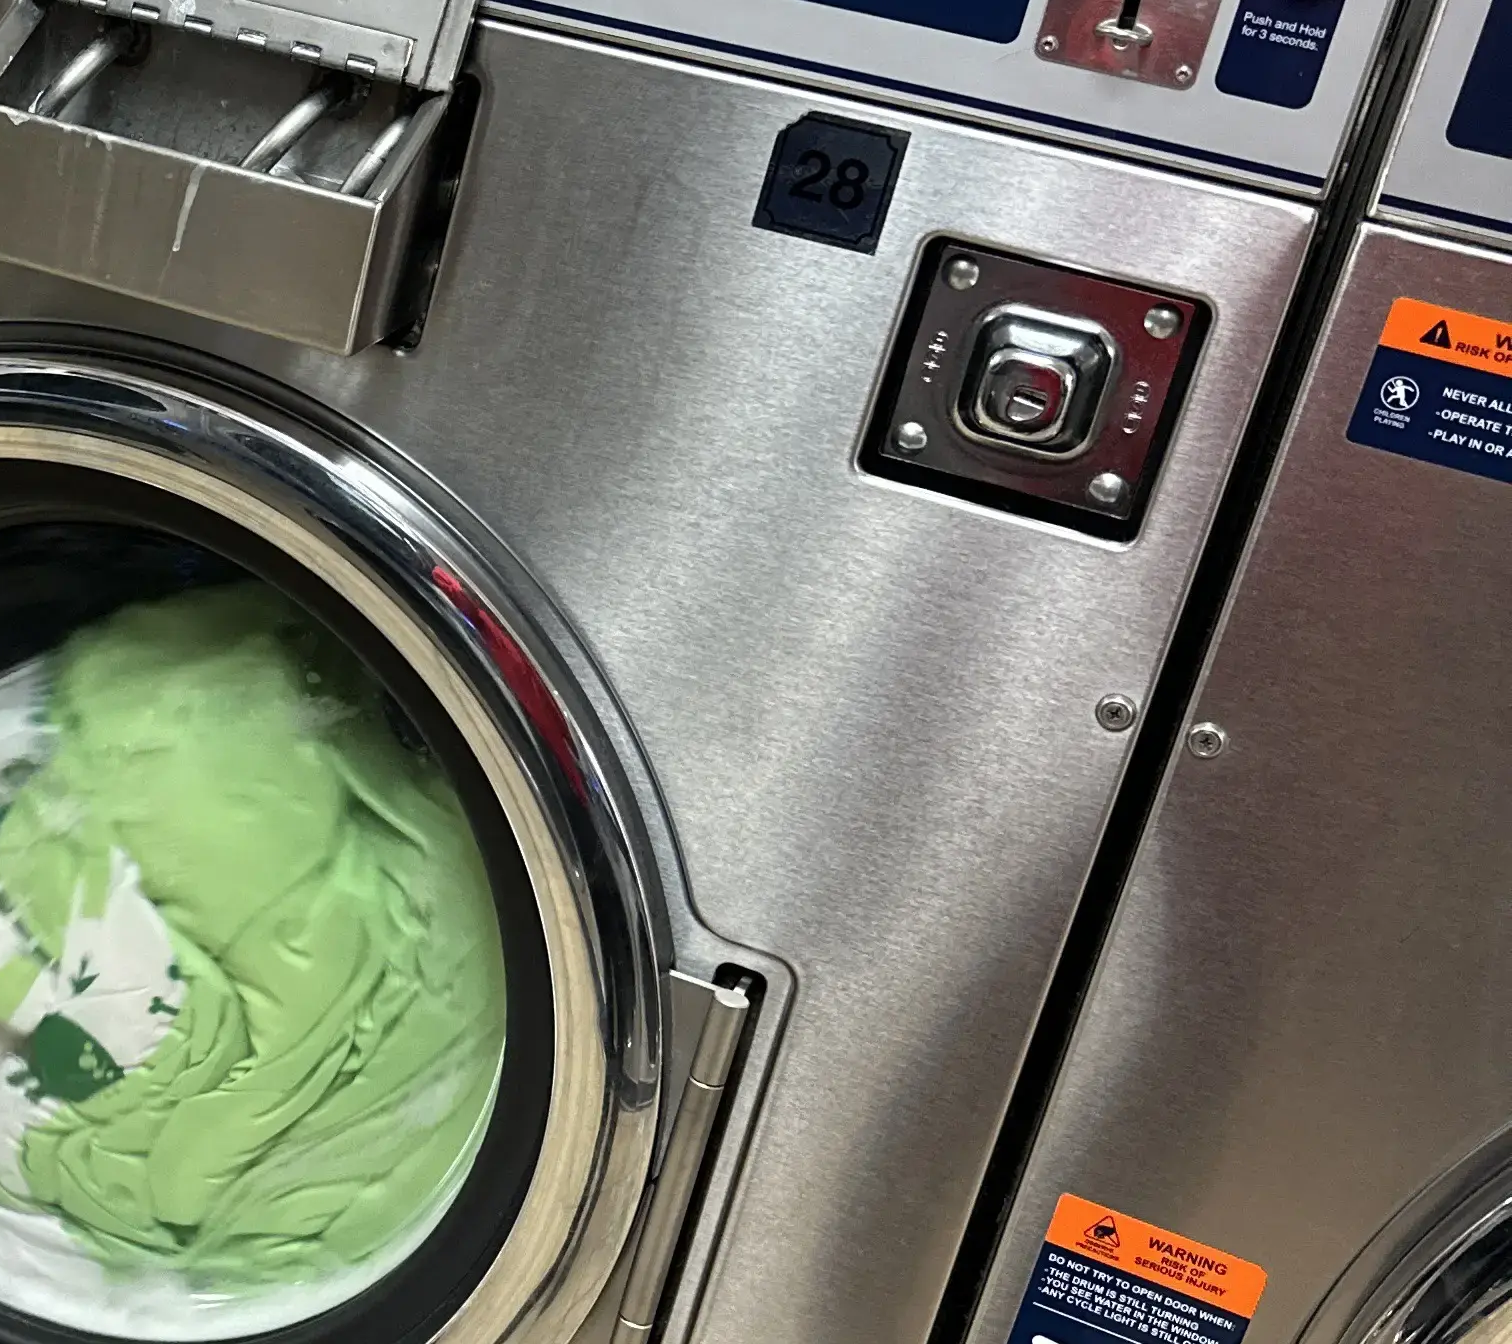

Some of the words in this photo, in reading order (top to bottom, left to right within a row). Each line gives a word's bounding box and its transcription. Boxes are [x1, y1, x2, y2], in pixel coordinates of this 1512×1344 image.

[1241, 25, 1257, 37] for
[1259, 29, 1267, 39] 3
[1269, 31, 1319, 52] seconds.
[1243, 11, 1273, 29] Push
[1274, 18, 1298, 33] and
[1298, 21, 1327, 39] Hold
[787, 149, 871, 211] 28
[1455, 342, 1490, 359] RISK
[1442, 387, 1487, 408] NEVER
[1468, 438, 1482, 450] IN
[1484, 443, 1504, 456] OR
[1149, 1237, 1227, 1275] WARNING
[1160, 1256, 1188, 1272] RISK
[1189, 1268, 1206, 1278] OF
[1048, 1252, 1065, 1264] DO
[1066, 1259, 1090, 1274] NOT
[1092, 1268, 1113, 1282] TRY
[1115, 1277, 1130, 1289] TO
[1131, 1285, 1162, 1302] OPEN
[1163, 1297, 1197, 1316] DOOR
[1134, 1256, 1183, 1280] SERIOUS
[1185, 1275, 1226, 1296] INJURY
[1066, 1295, 1102, 1314] CYCLE
[1103, 1309, 1136, 1327] LIGHT
[1137, 1322, 1148, 1332] IS
[1150, 1327, 1179, 1344] STILL
[1070, 1286, 1092, 1300] SEE
[1094, 1294, 1131, 1315] WATER
[1132, 1310, 1145, 1320] IN
[1147, 1315, 1168, 1329] THE
[1071, 1276, 1104, 1294] DRUM
[1105, 1288, 1116, 1298] IS
[1118, 1294, 1147, 1311] STILL
[1151, 1305, 1198, 1330] TURNING
